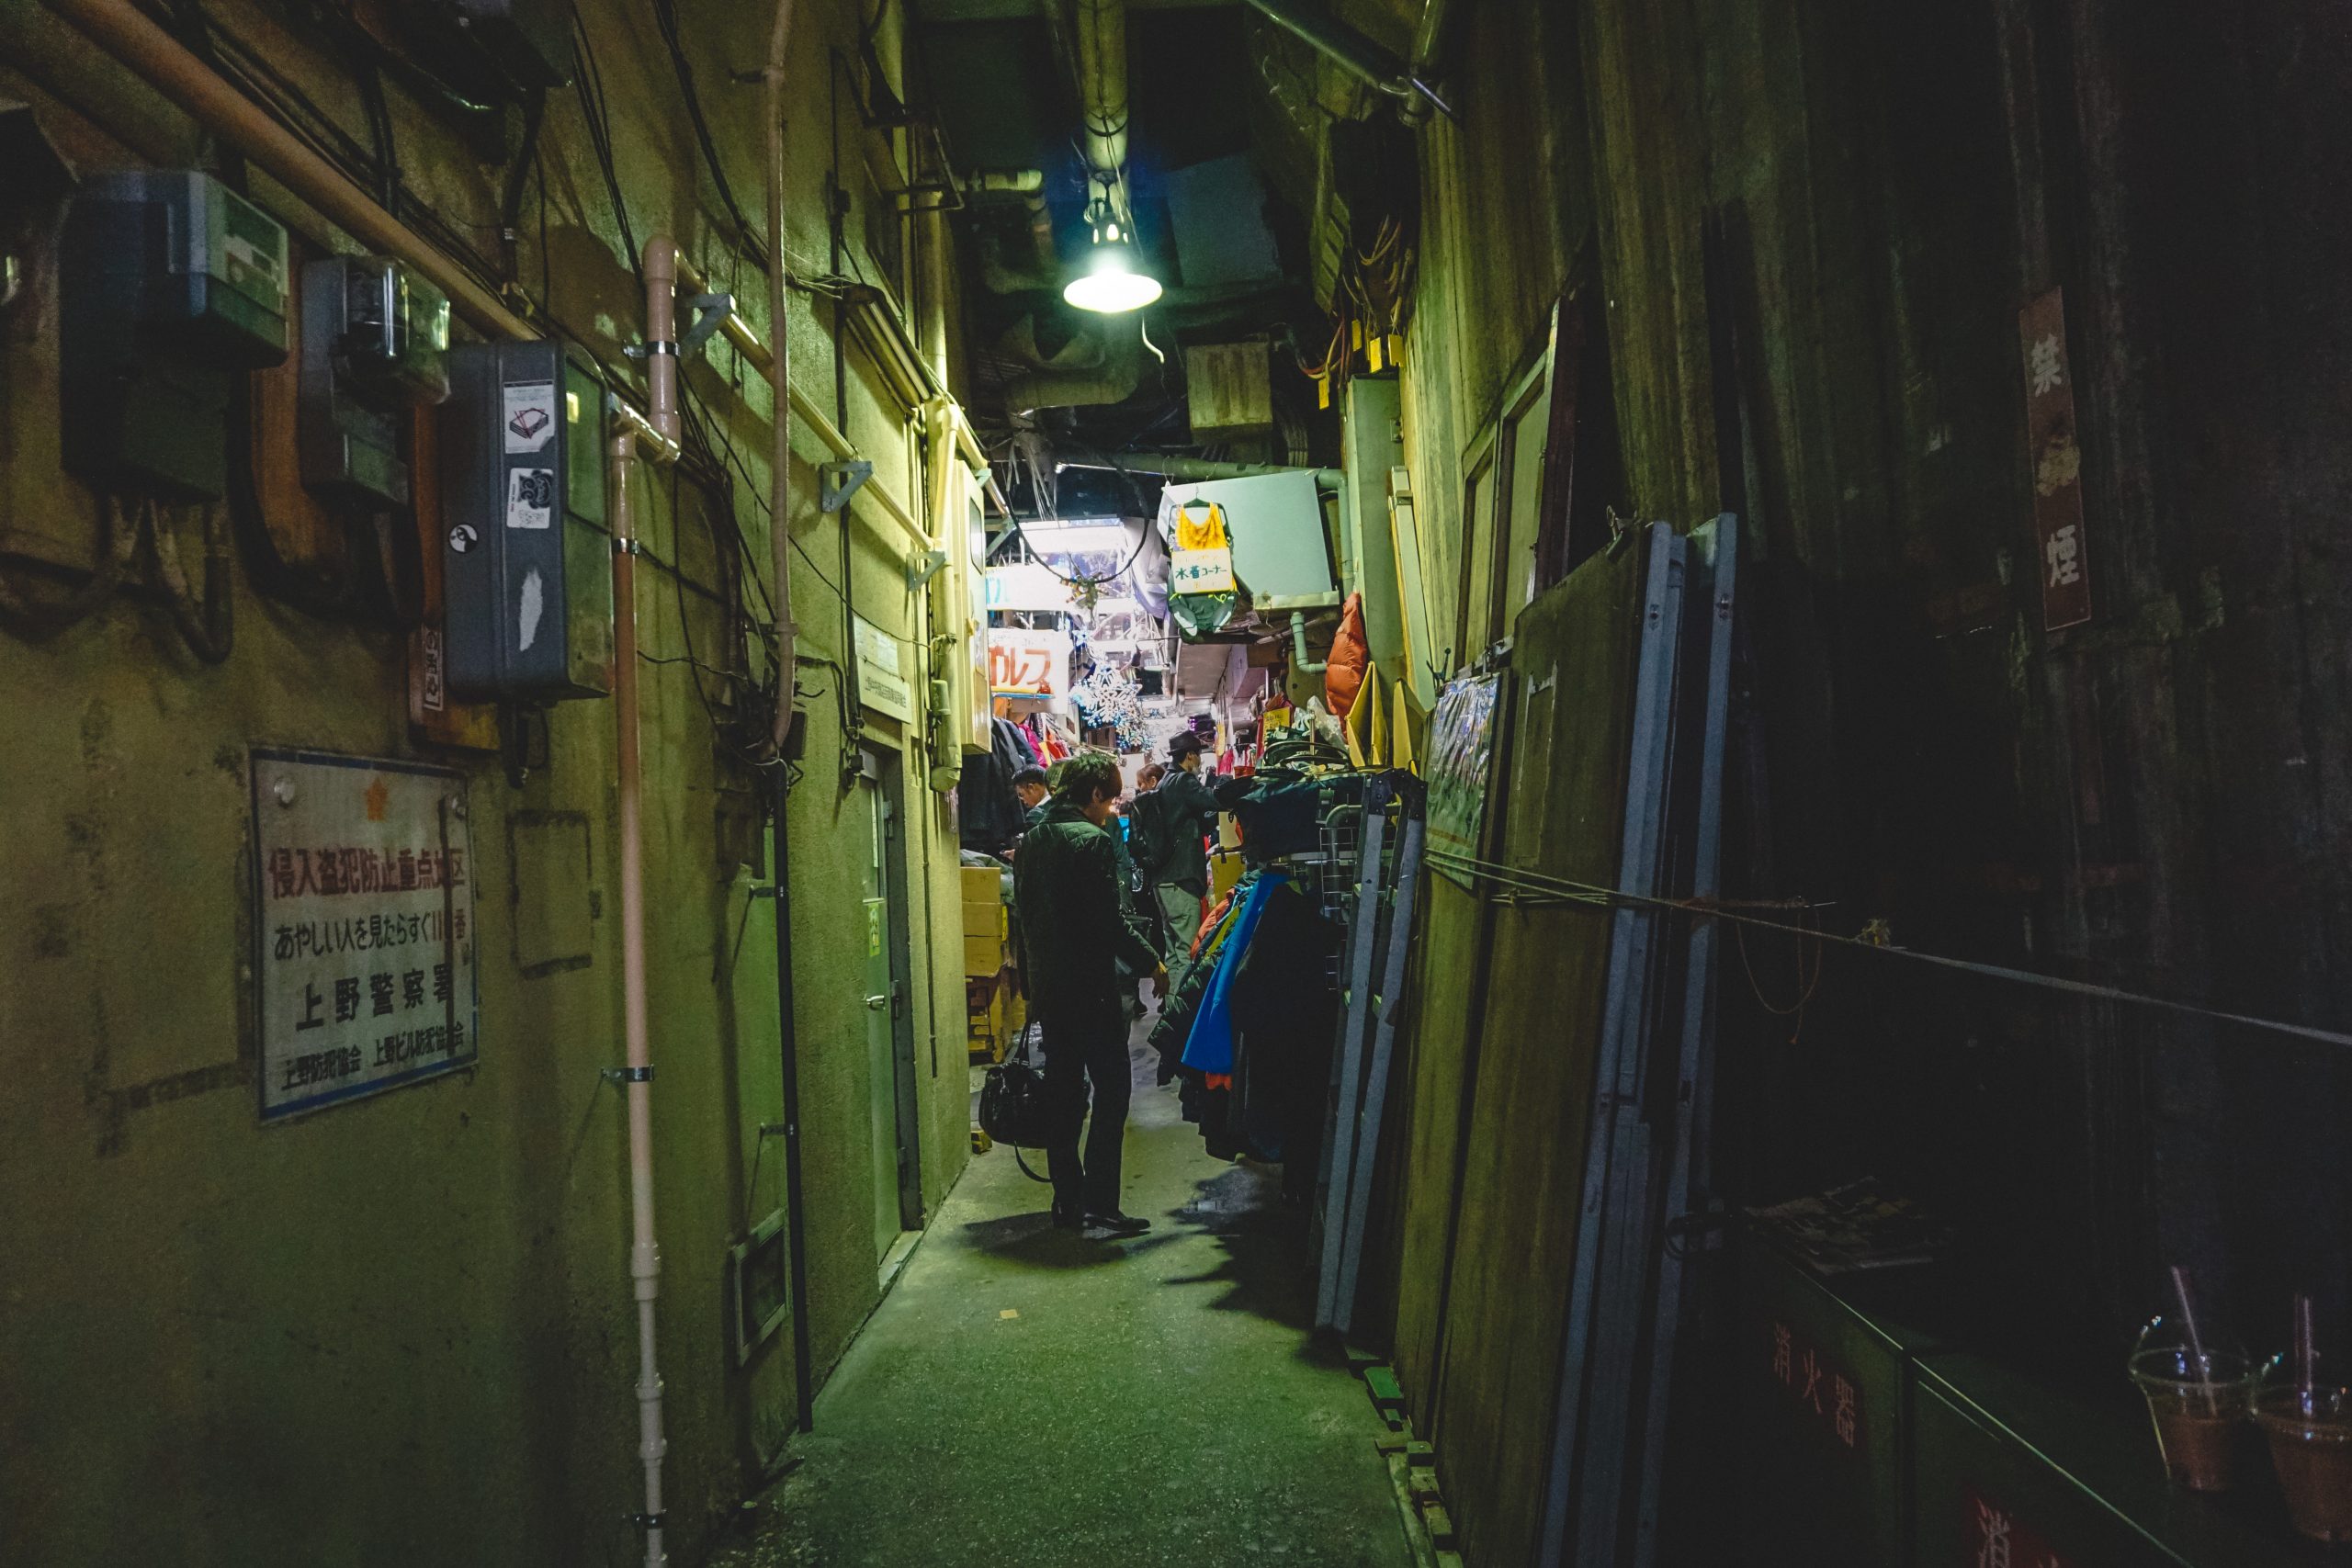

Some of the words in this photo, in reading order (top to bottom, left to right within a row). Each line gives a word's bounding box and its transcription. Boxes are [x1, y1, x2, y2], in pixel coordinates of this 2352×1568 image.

[1175, 564, 1227, 581] 水着コーナー
[275, 908, 466, 961] あやしい人を見たらすぐ11番
[296, 963, 453, 1032] 上野警察署
[1773, 1322, 1855, 1449] 消火器
